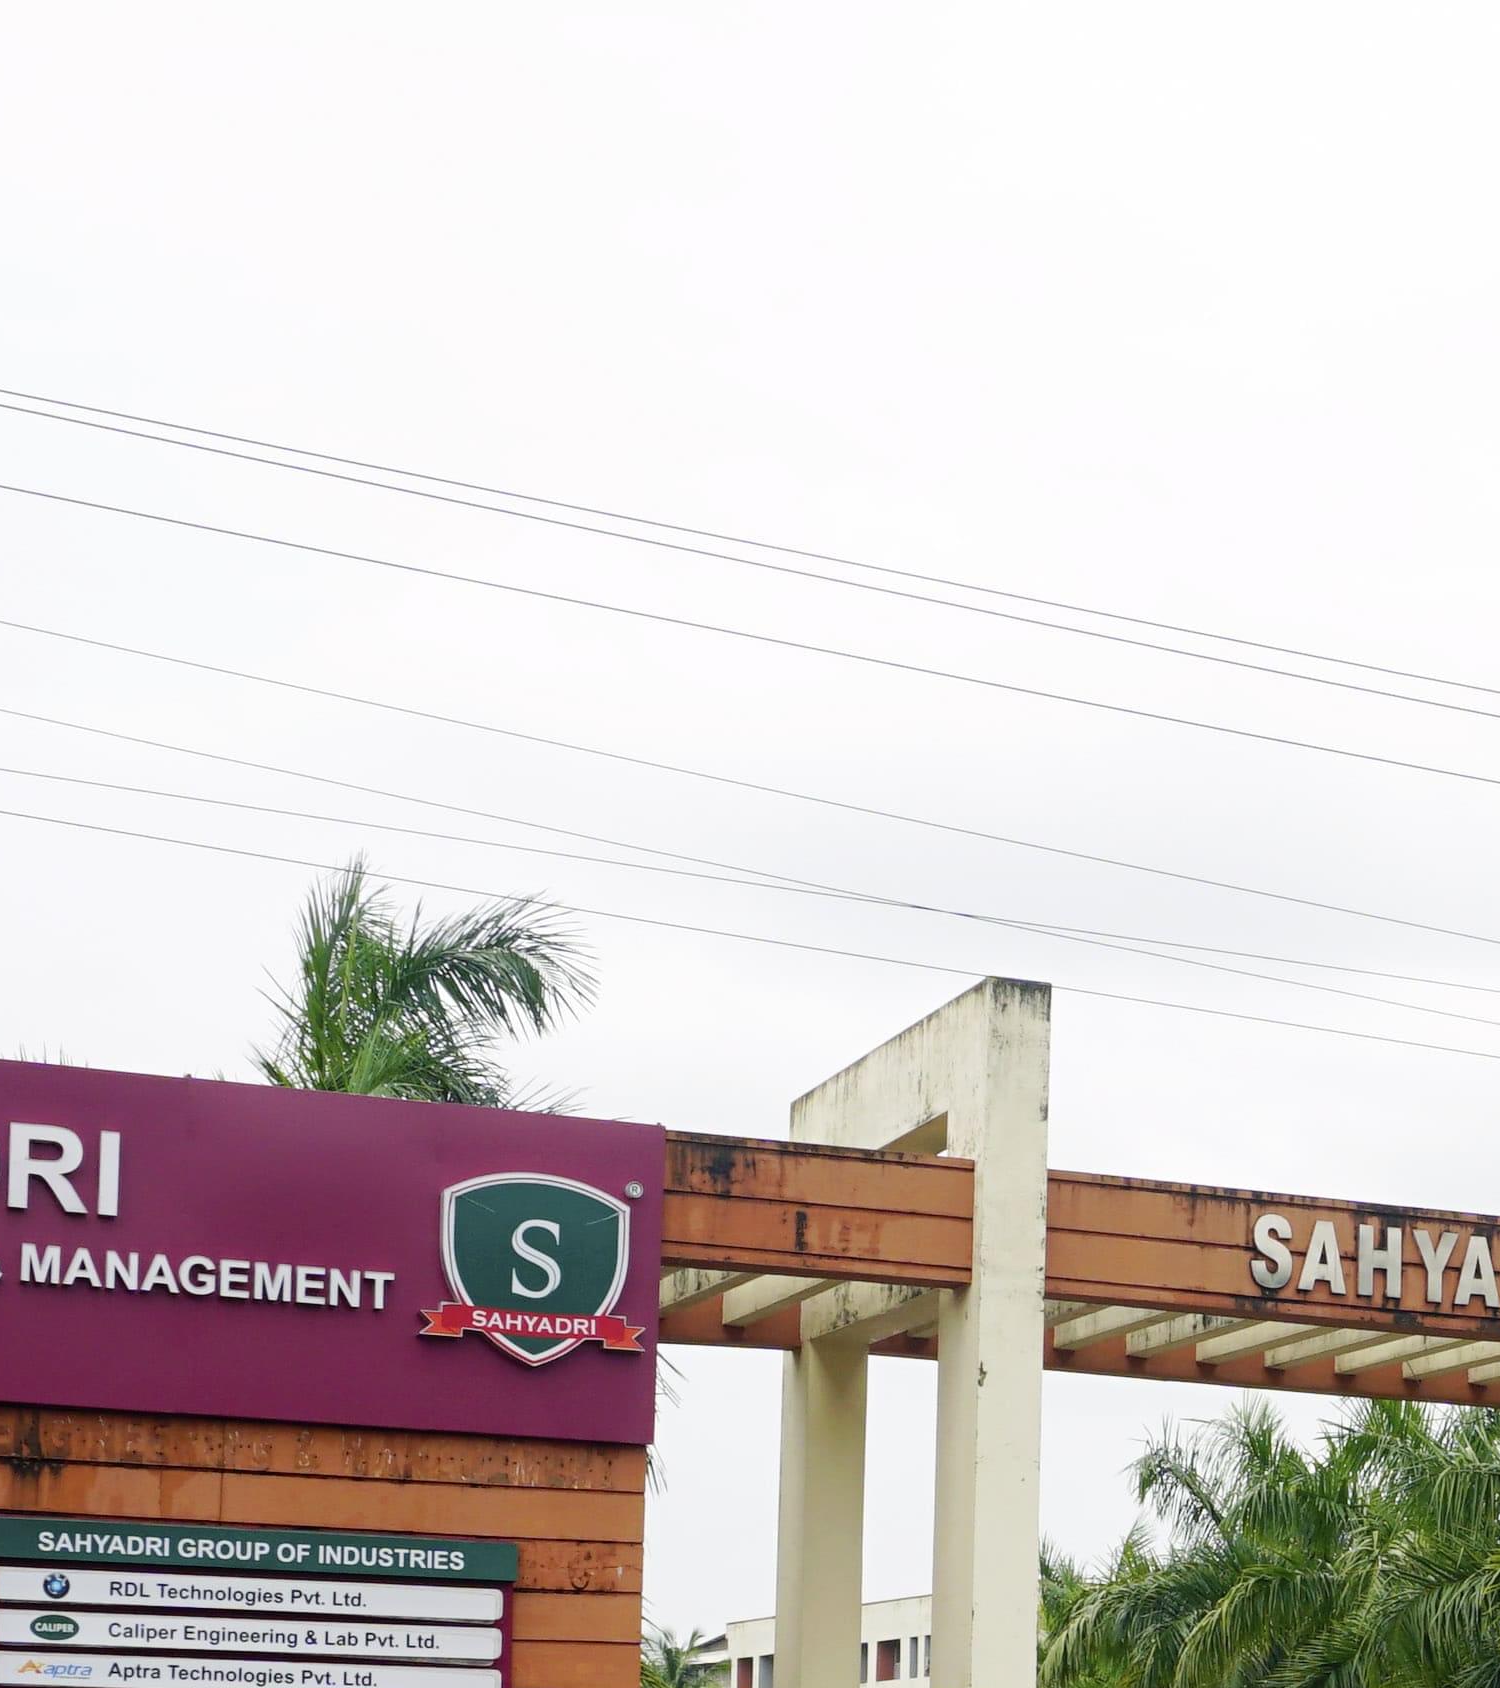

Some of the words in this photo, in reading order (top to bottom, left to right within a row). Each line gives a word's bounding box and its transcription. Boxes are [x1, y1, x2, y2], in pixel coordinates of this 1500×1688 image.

[511, 1218, 562, 1299] S
[21, 1243, 395, 1310] MANAGEMENT
[471, 1310, 597, 1336] SAHYADRI
[37, 1532, 170, 1558] SAHYADRI
[177, 1540, 269, 1563] GROUP
[277, 1543, 310, 1564] OF
[318, 1545, 464, 1571] INDUSTRIES
[109, 1581, 150, 1599] RDL
[158, 1584, 284, 1604] Technologies
[290, 1588, 325, 1606] Pvt.
[332, 1589, 367, 1608] Ltd.
[35, 1622, 74, 1633] CALIPER
[108, 1623, 177, 1645] Caliper
[184, 1625, 298, 1648] Engineering
[305, 1630, 317, 1646] &
[324, 1630, 357, 1647] Lab
[365, 1632, 399, 1648] Pvt.
[405, 1632, 440, 1650] Ltd.
[44, 1664, 93, 1678] aptra
[108, 1662, 160, 1683] Aptra
[167, 1664, 294, 1687] Technologies
[301, 1669, 336, 1686] Pvt.
[343, 1669, 377, 1688] Ltd.
